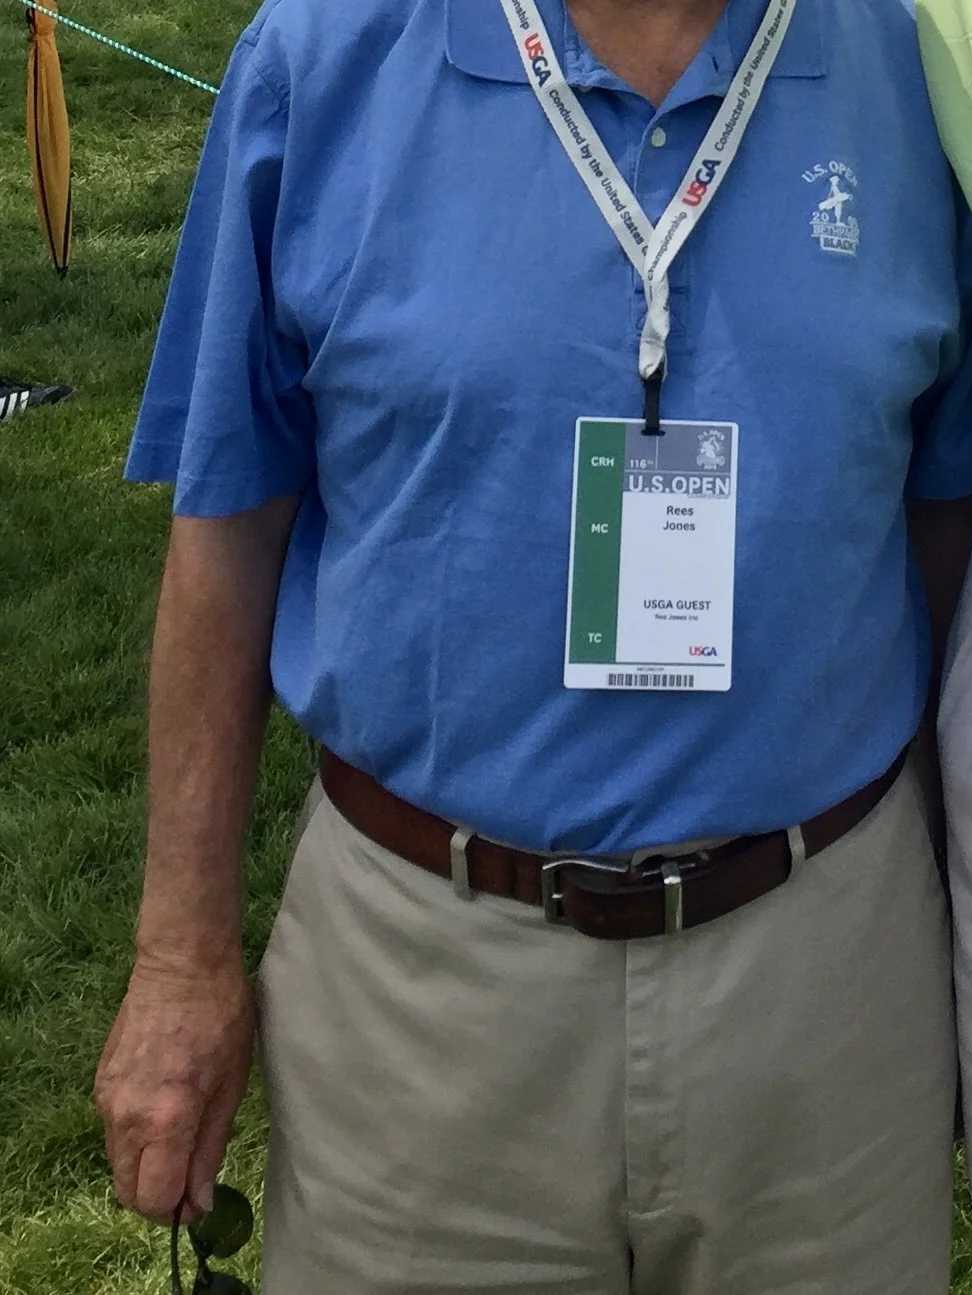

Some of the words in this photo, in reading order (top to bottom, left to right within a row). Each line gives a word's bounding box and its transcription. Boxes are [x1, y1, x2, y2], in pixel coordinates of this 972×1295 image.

[767, 8, 784, 38] States
[750, 37, 770, 71] United
[743, 70, 754, 88] the
[739, 86, 751, 100] by
[714, 98, 745, 152] Conducted
[524, 32, 552, 88] USGA
[549, 89, 586, 146] Conducted
[580, 142, 592, 160] by
[588, 156, 603, 178] the
[601, 177, 625, 213] United
[620, 210, 644, 245] States
[682, 159, 721, 207] USGA
[648, 211, 688, 281] Championship
[591, 457, 615, 467] CRH
[666, 505, 694, 516] Rees
[591, 524, 609, 533] MC
[663, 521, 696, 531] Jones
[643, 599, 673, 609] USGA
[676, 600, 712, 610] GUEST
[588, 633, 603, 643] TC
[688, 646, 717, 657] USGA
